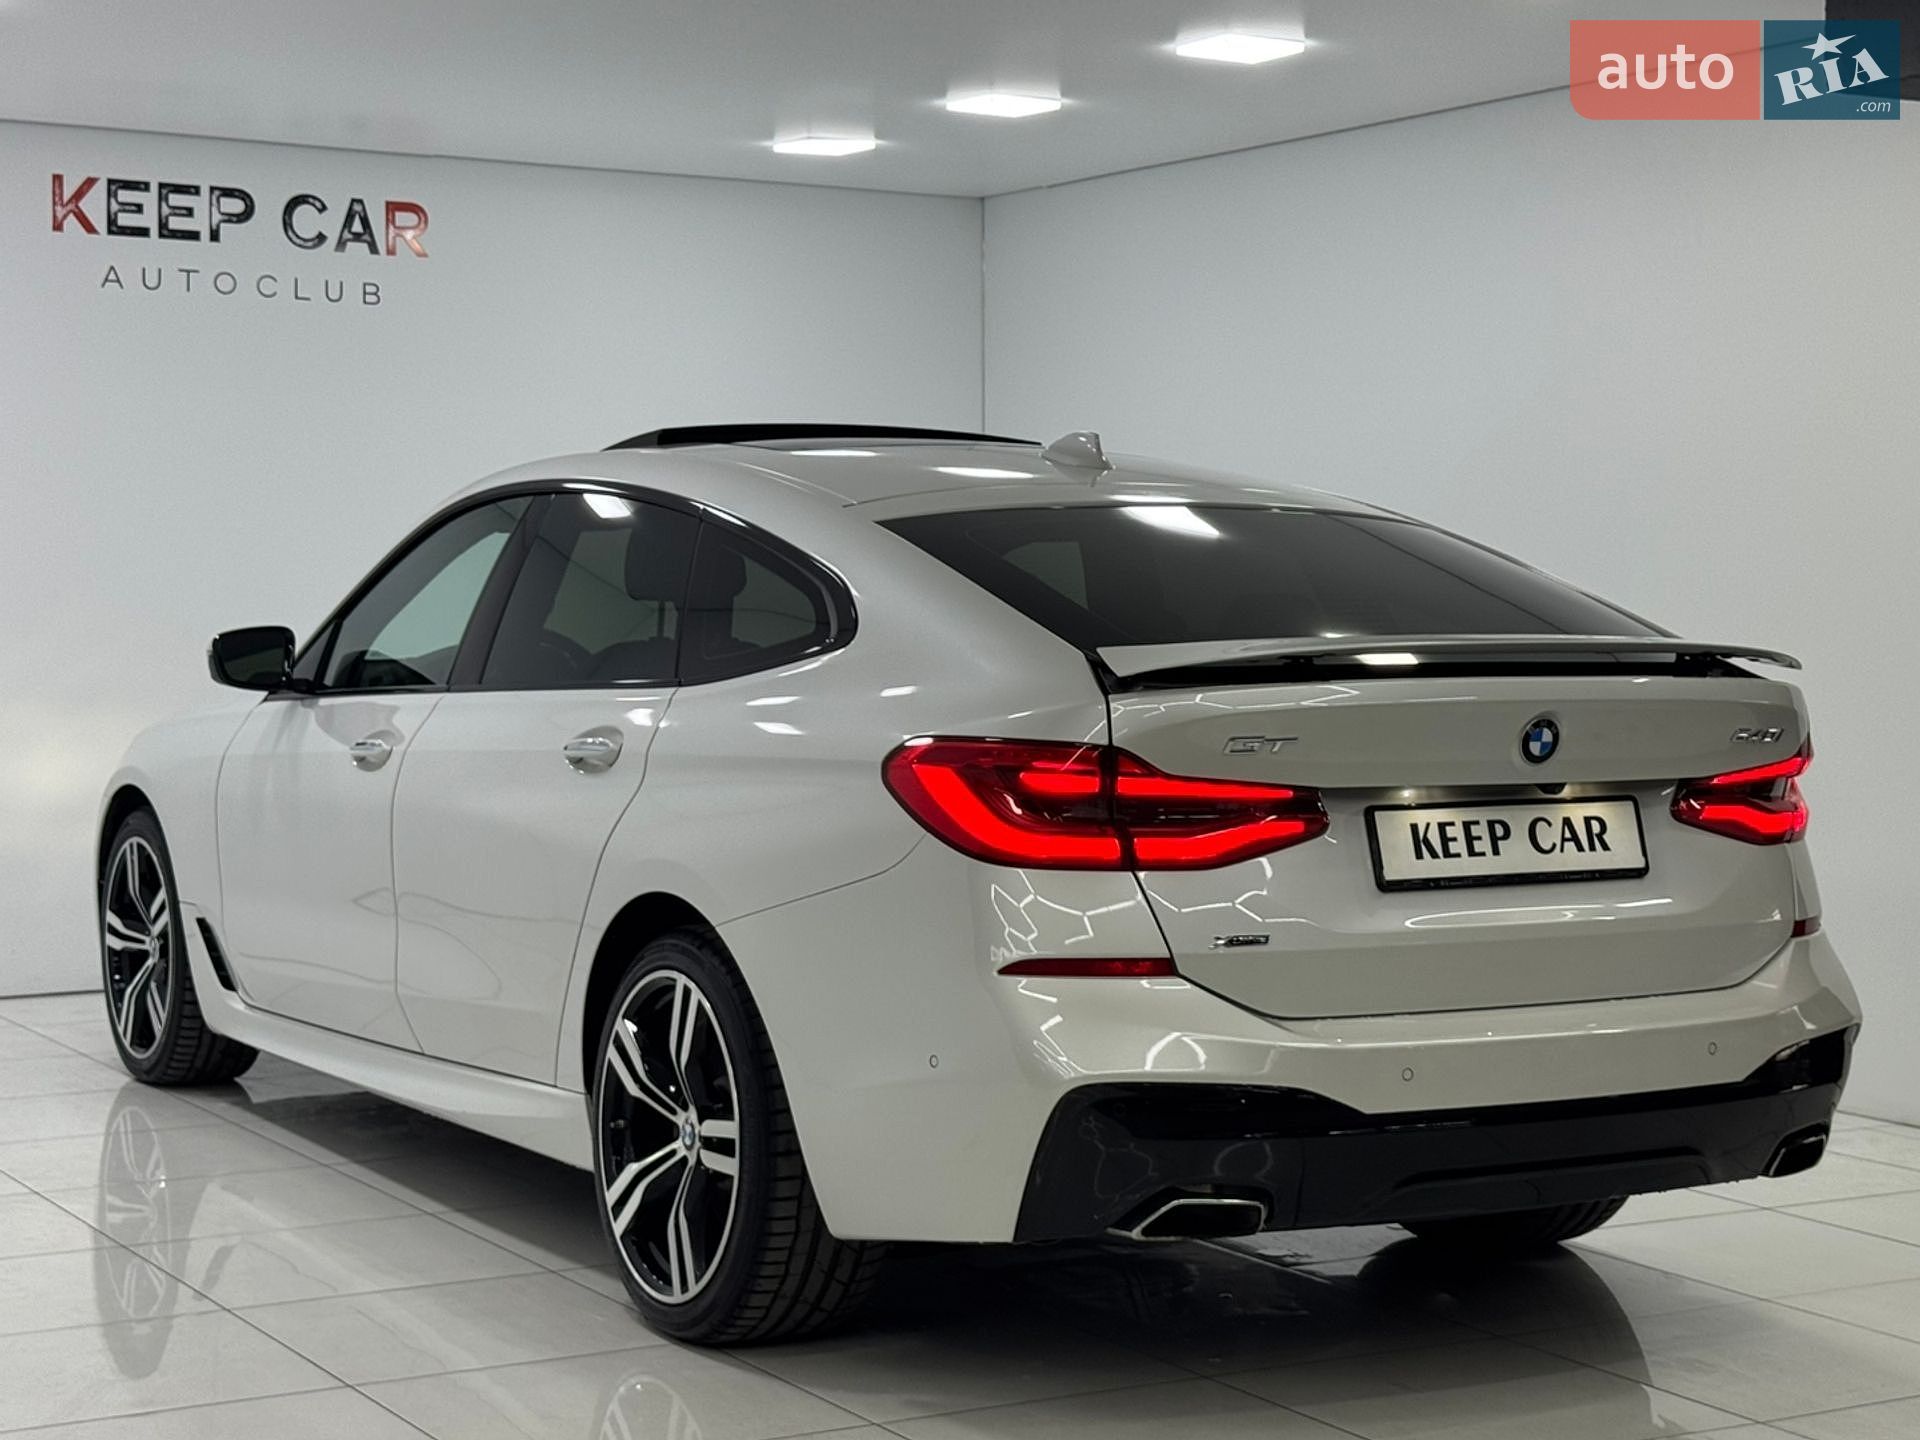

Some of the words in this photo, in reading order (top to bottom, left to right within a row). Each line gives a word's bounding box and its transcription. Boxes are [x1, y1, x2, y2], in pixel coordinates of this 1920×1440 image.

[51, 173, 256, 243] KEEP
[281, 193, 430, 259] CAR
[101, 265, 382, 306] AUTOCLUB
[1223, 734, 1299, 755] GT
[1409, 818, 1512, 861] KEEP
[1527, 815, 1612, 855] CAR
